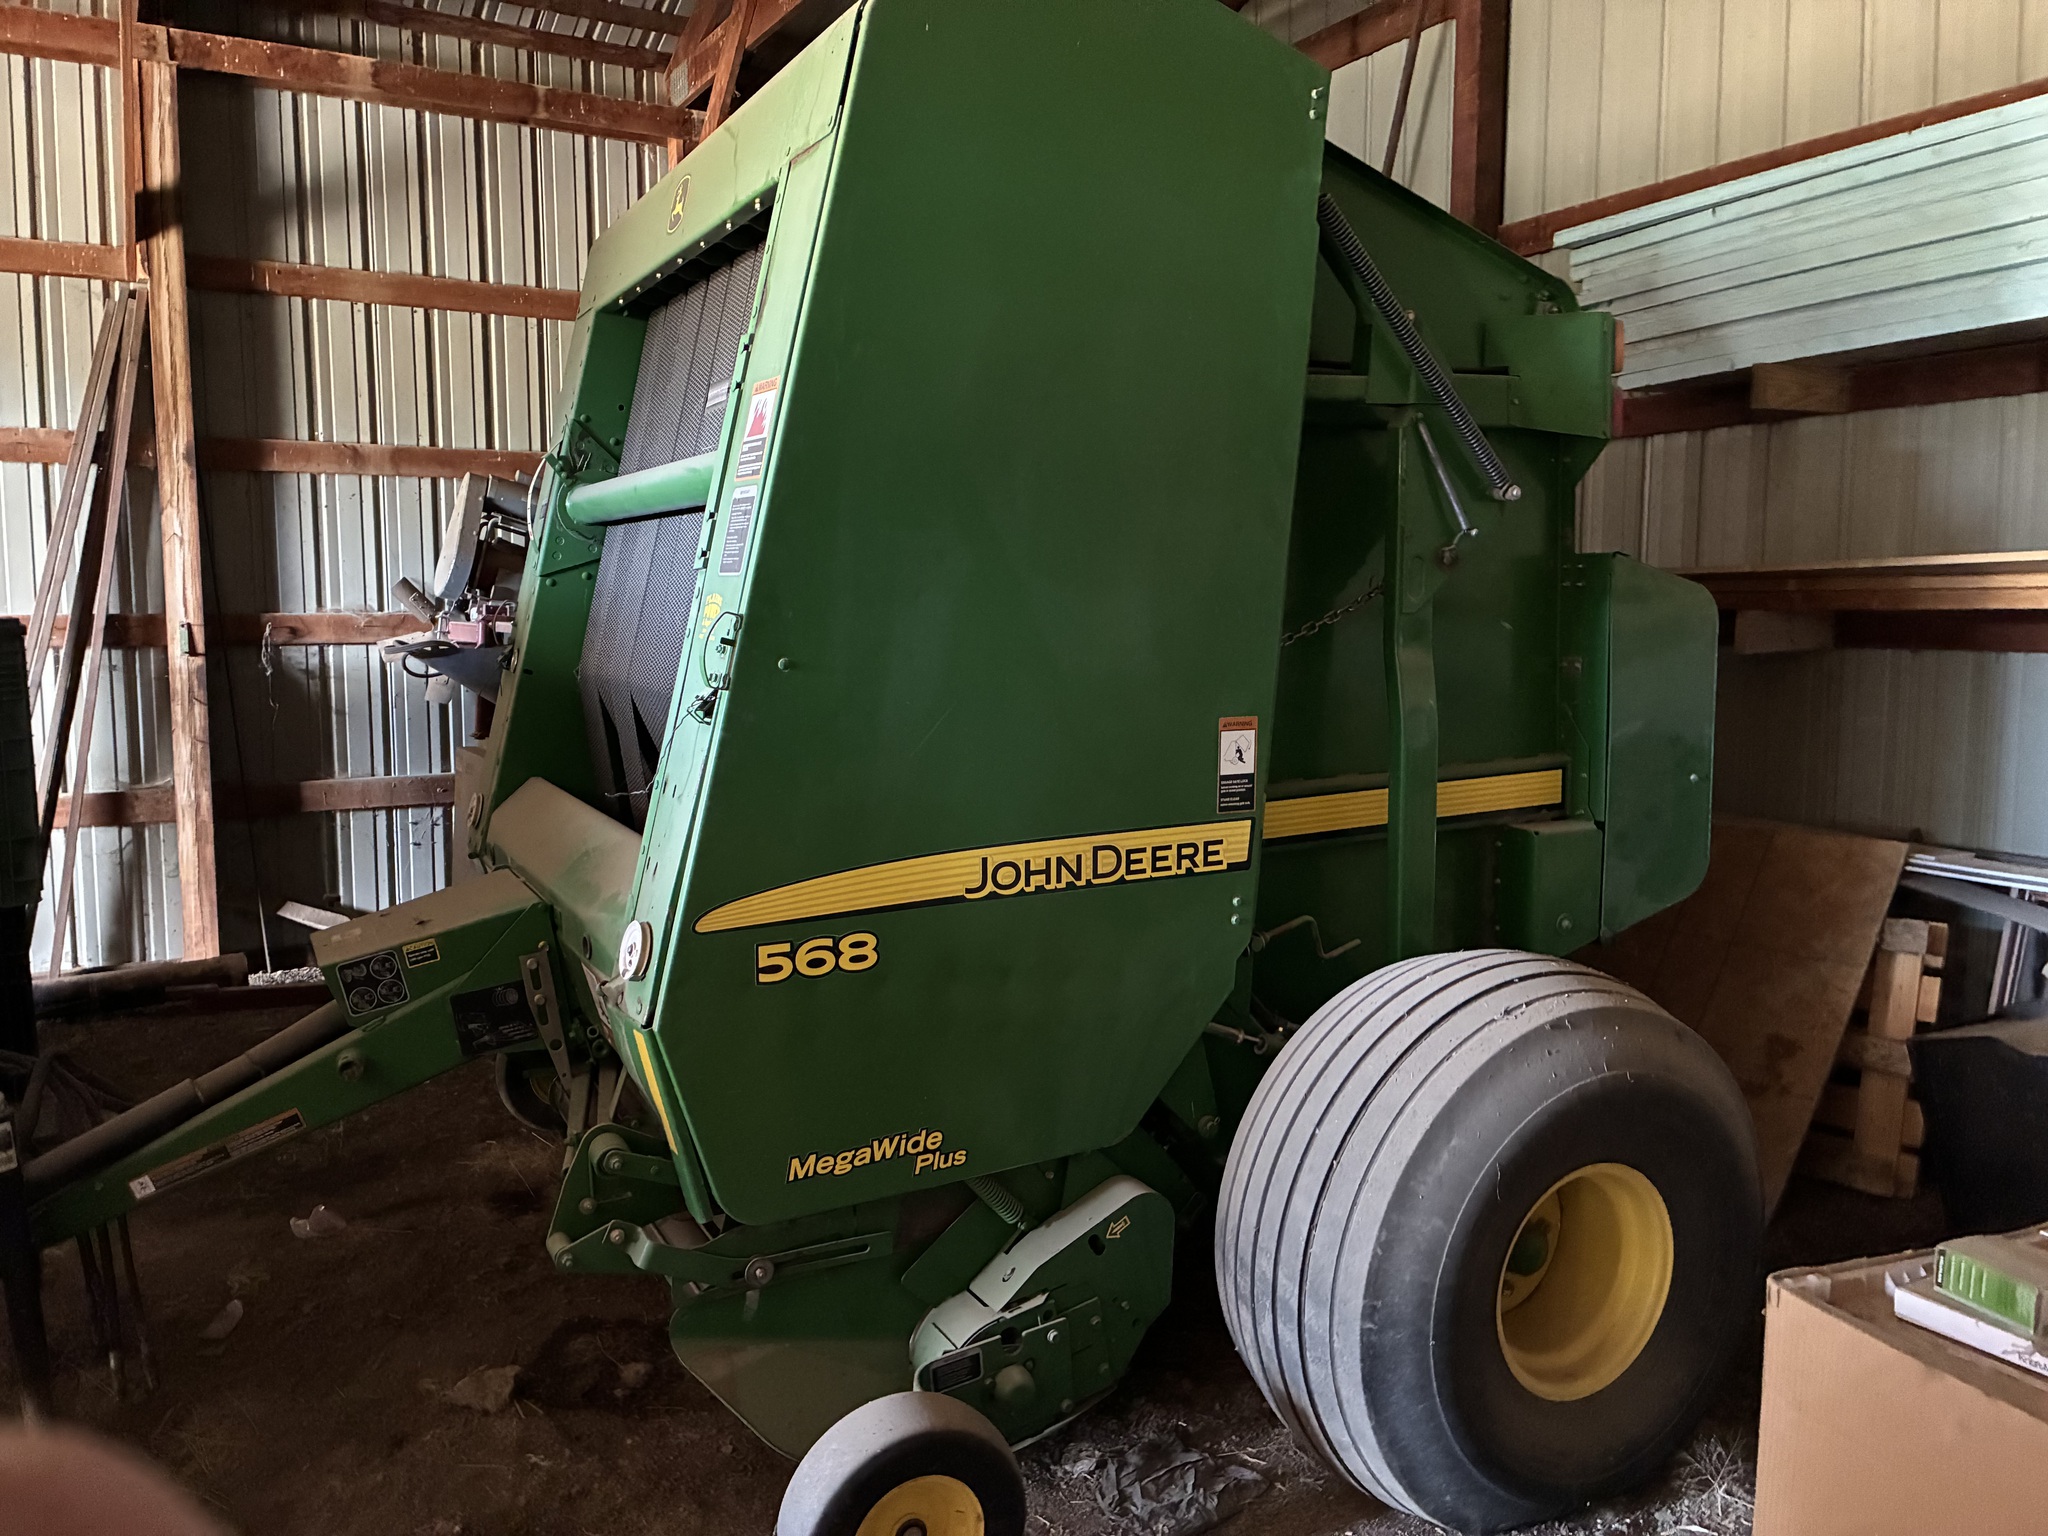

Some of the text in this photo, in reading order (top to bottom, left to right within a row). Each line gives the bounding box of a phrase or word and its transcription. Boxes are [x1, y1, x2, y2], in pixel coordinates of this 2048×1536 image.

[1226, 720, 1253, 728] WARNING
[964, 838, 1225, 896] JOHN DEERE
[757, 931, 878, 984] 568
[787, 1128, 944, 1182] MegaWide
[913, 1149, 968, 1176] Plus
